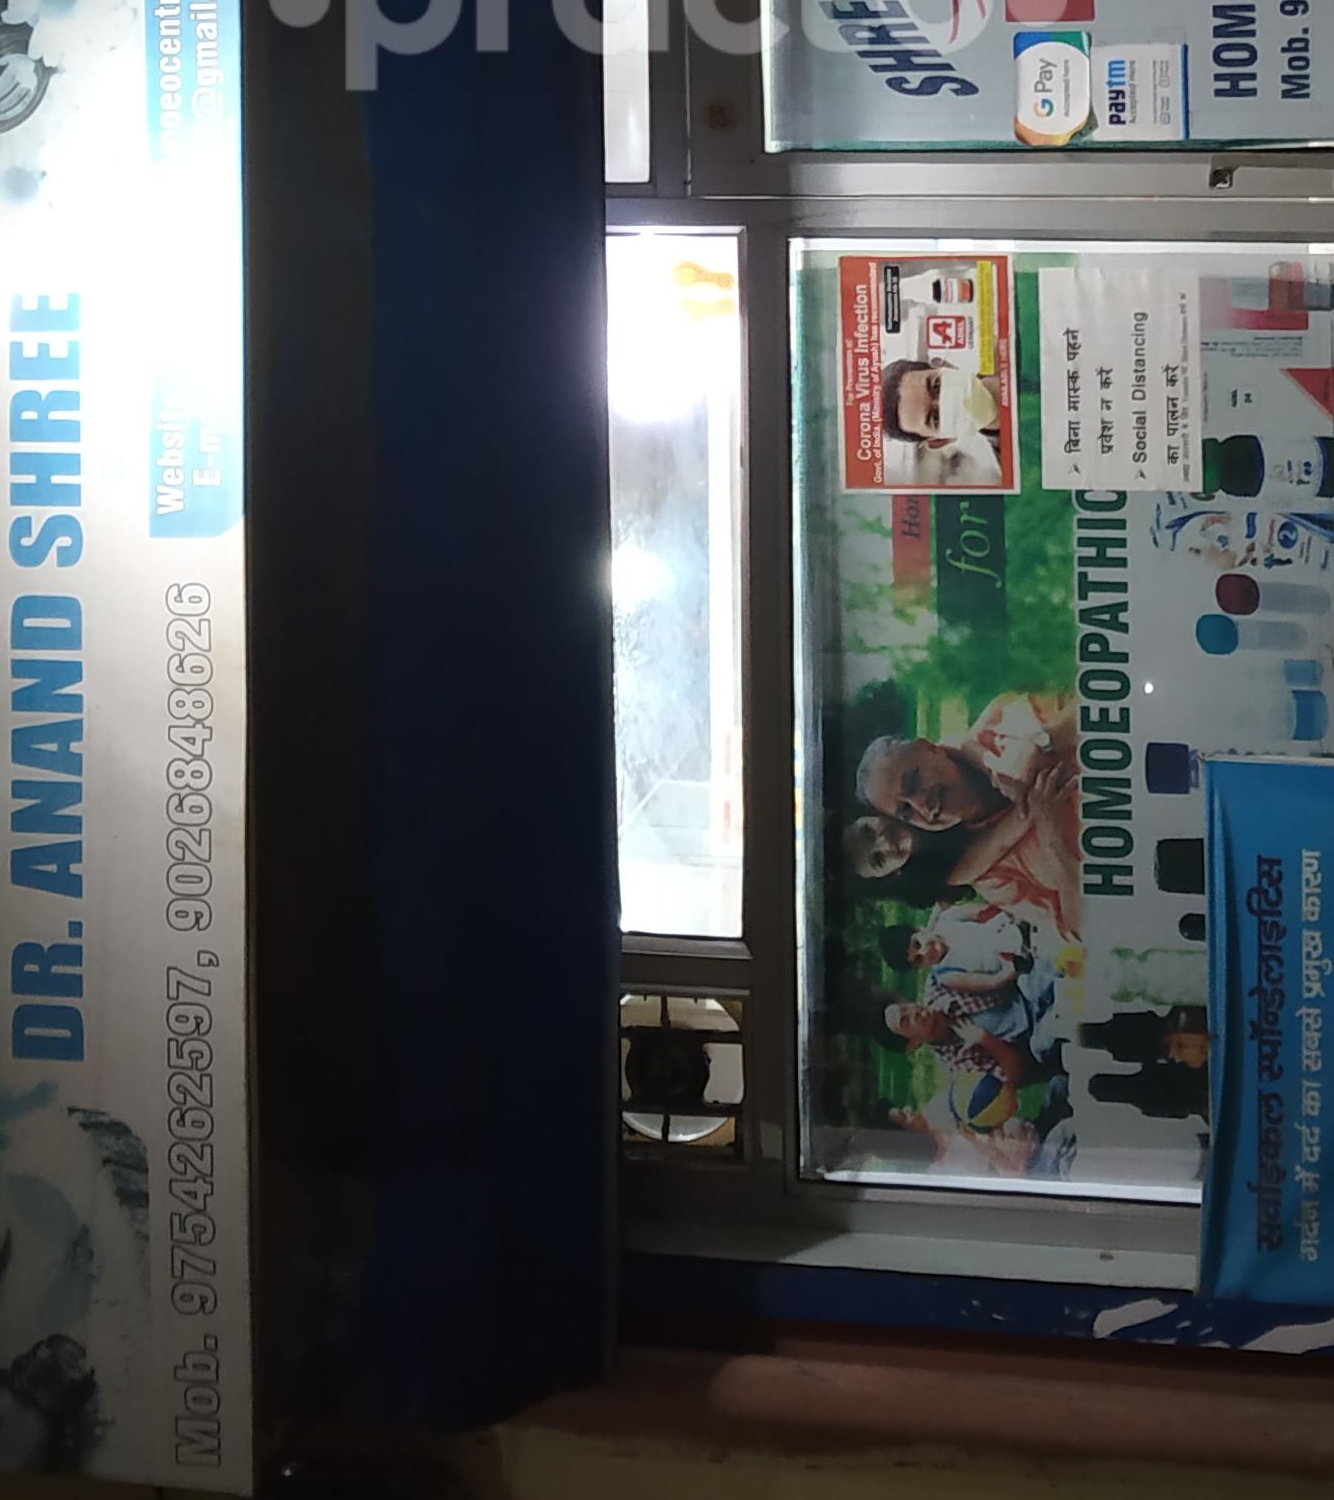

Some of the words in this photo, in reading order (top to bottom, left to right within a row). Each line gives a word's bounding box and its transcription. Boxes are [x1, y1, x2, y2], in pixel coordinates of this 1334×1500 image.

[1033, 58, 1057, 93] Pay
[1279, 26, 1311, 100] Mob.
[854, 284, 870, 353] Infection
[1062, 327, 1082, 361] पहने
[856, 358, 871, 398] Virus
[1095, 366, 1113, 390] करें
[1131, 311, 1149, 401] Distancing
[1161, 363, 1180, 388] करें
[1065, 369, 1081, 412] मास्क
[1099, 398, 1113, 411] न
[1166, 396, 1180, 437] पालन
[857, 402, 872, 461] Corona
[1064, 420, 1081, 454] बिना
[1097, 418, 1114, 454] प्रवेश
[1132, 410, 1148, 464] Social
[1166, 445, 1180, 465] का
[944, 501, 1002, 589] for
[1074, 491, 1135, 896] HOMOEOPATHIC
[8, 594, 85, 899] ANAND
[163, 581, 215, 931] 9026848626
[1299, 848, 1324, 922] कारण
[9, 920, 85, 1061] DR.
[1299, 928, 1334, 998] प्रमुख
[1294, 1006, 1324, 1073] सबसे
[1299, 1078, 1323, 1116] का
[165, 948, 220, 1315] 9754262597,
[1294, 1122, 1323, 1163] दर्द
[1246, 1089, 1287, 1252] सर्वाइकल
[1292, 1164, 1322, 1194] में
[1293, 1200, 1322, 1262] गर्दन
[174, 1334, 221, 1467] Mob.
